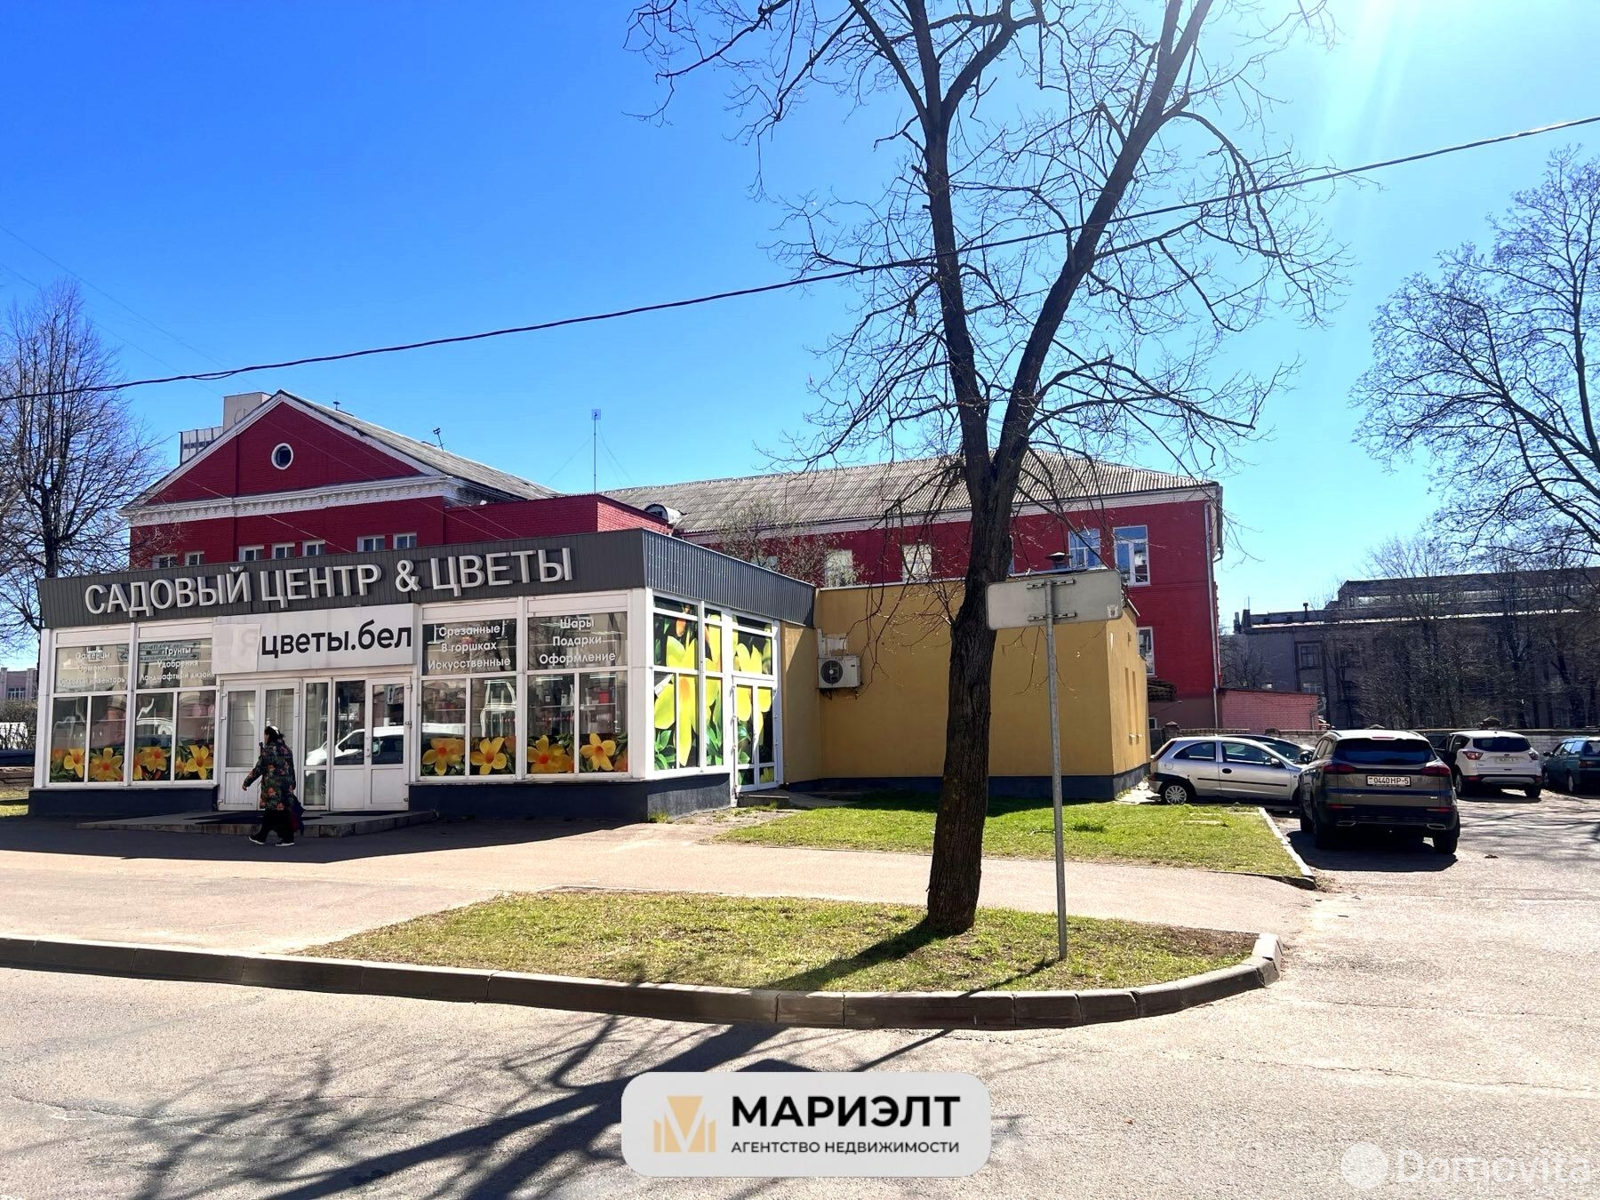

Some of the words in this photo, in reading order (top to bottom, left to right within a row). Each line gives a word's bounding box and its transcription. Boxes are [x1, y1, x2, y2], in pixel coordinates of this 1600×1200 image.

[84, 565, 252, 618] САДОВЫЙ
[259, 563, 382, 609] ЦЕНТР
[395, 559, 422, 593] &
[430, 547, 573, 597] ЦВЕТЫ
[438, 624, 501, 638] Срезанные
[560, 617, 595, 631] Шары
[261, 619, 412, 659] цветы.бел
[552, 635, 602, 648] Подарки
[440, 643, 449, 653] В
[451, 642, 497, 655] горшках
[428, 657, 511, 671] Искусственные
[539, 651, 616, 667] Оформление
